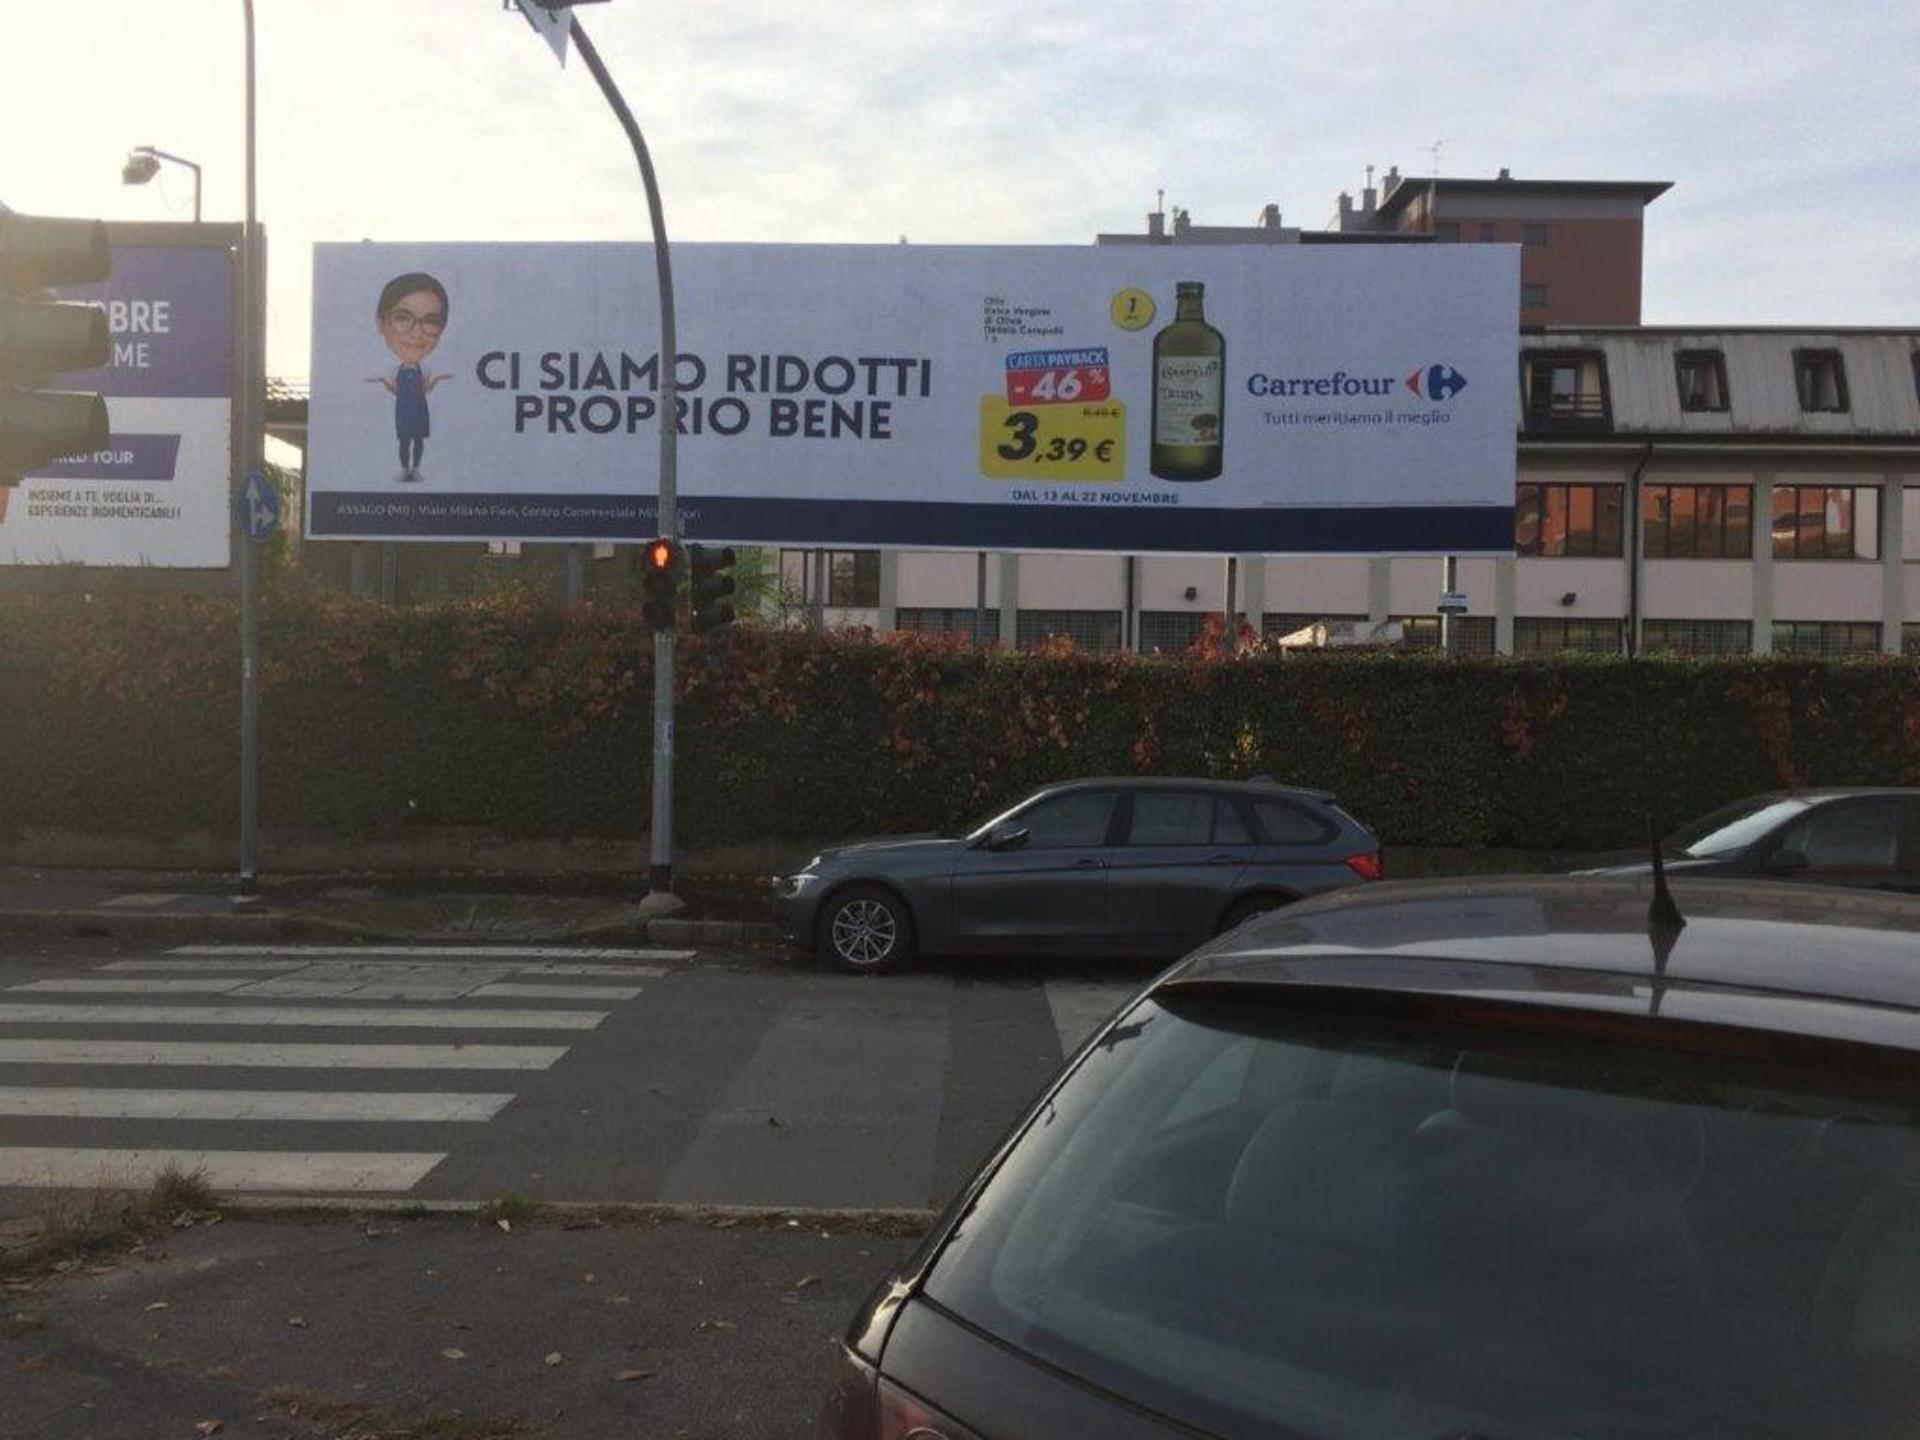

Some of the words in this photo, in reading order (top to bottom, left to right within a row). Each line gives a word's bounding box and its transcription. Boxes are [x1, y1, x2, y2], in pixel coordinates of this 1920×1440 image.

[98, 300, 170, 333] BRE
[475, 351, 520, 390] CI
[540, 350, 707, 392] SIAMO
[726, 354, 931, 397] RIDOTTI
[1247, 371, 1395, 396] Carrefour
[769, 399, 891, 439] BENE
[1264, 412, 1298, 425] Tutti
[1303, 411, 1381, 424] meritiamo
[1385, 411, 1393, 424] il
[1397, 410, 1450, 426] meglio
[998, 412, 1087, 463] 3,39
[1094, 439, 1115, 463] €
[93, 450, 134, 464] TOUR
[28, 490, 72, 502] INSIEME
[75, 491, 82, 502] A
[103, 490, 142, 503] VOGLIA
[1012, 490, 1038, 501] DAL
[1061, 491, 1080, 501] AL
[1082, 491, 1096, 502] 22
[1100, 492, 1179, 505] NOVEMBRE
[28, 505, 88, 517] ESPERIENZE
